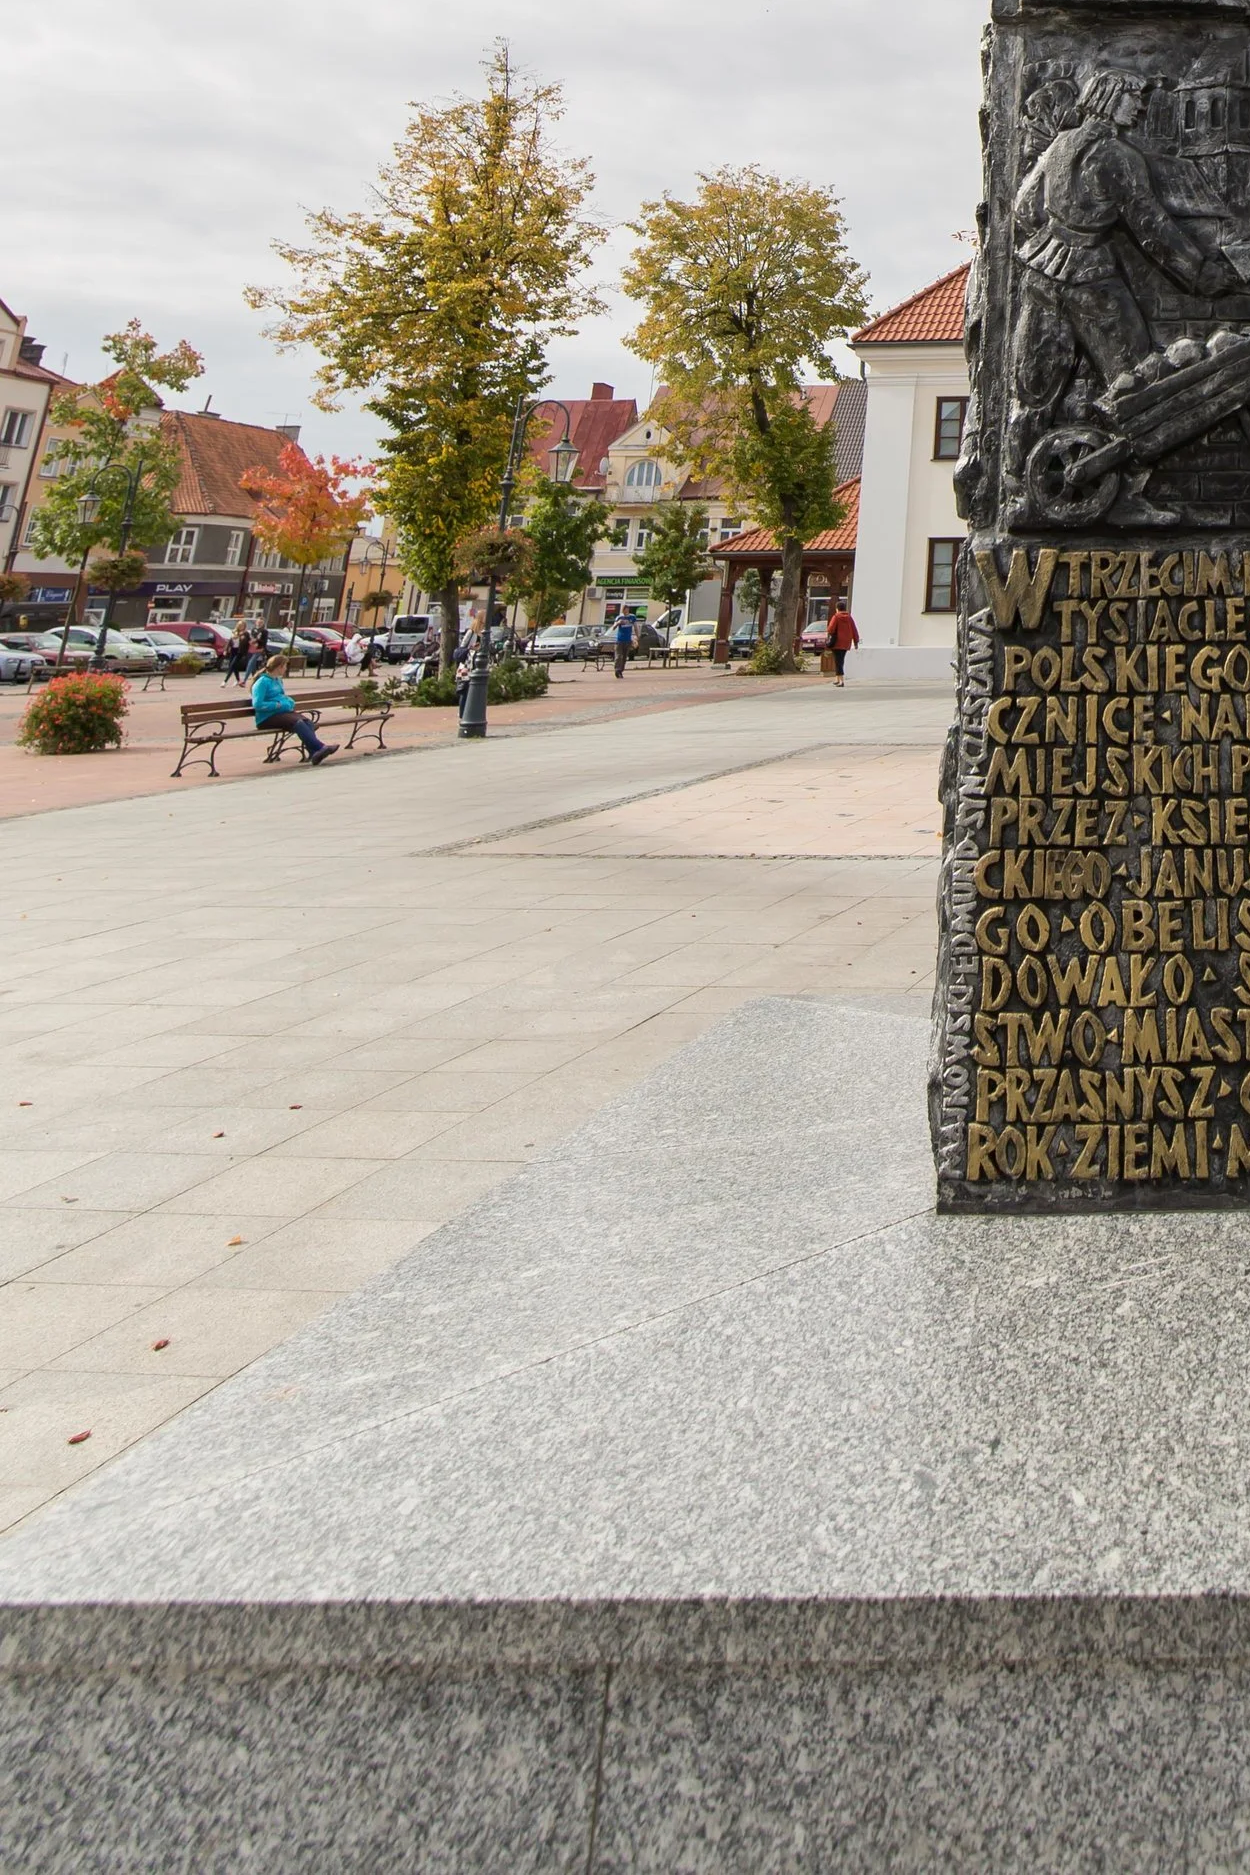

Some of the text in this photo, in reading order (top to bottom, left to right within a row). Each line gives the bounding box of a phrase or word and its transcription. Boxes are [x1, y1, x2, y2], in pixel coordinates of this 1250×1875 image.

[156, 583, 193, 593] PLAY
[974, 547, 1059, 630] W
[1058, 549, 1236, 598] TRZECIM
[980, 743, 1220, 797] MIEJSKICH
[956, 774, 989, 830] SYN
[988, 796, 1129, 847] PRZEZ
[950, 839, 980, 967] EDMUND
[973, 848, 1112, 901] CKIEGO
[974, 902, 1051, 956] GO
[979, 952, 1195, 1012] DOWAŁO
[969, 1008, 1106, 1069] STWO
[975, 1064, 1218, 1124] PRZASNYSZ
[966, 1121, 1057, 1182] ROK
[1068, 1119, 1210, 1183] ZIEMI
